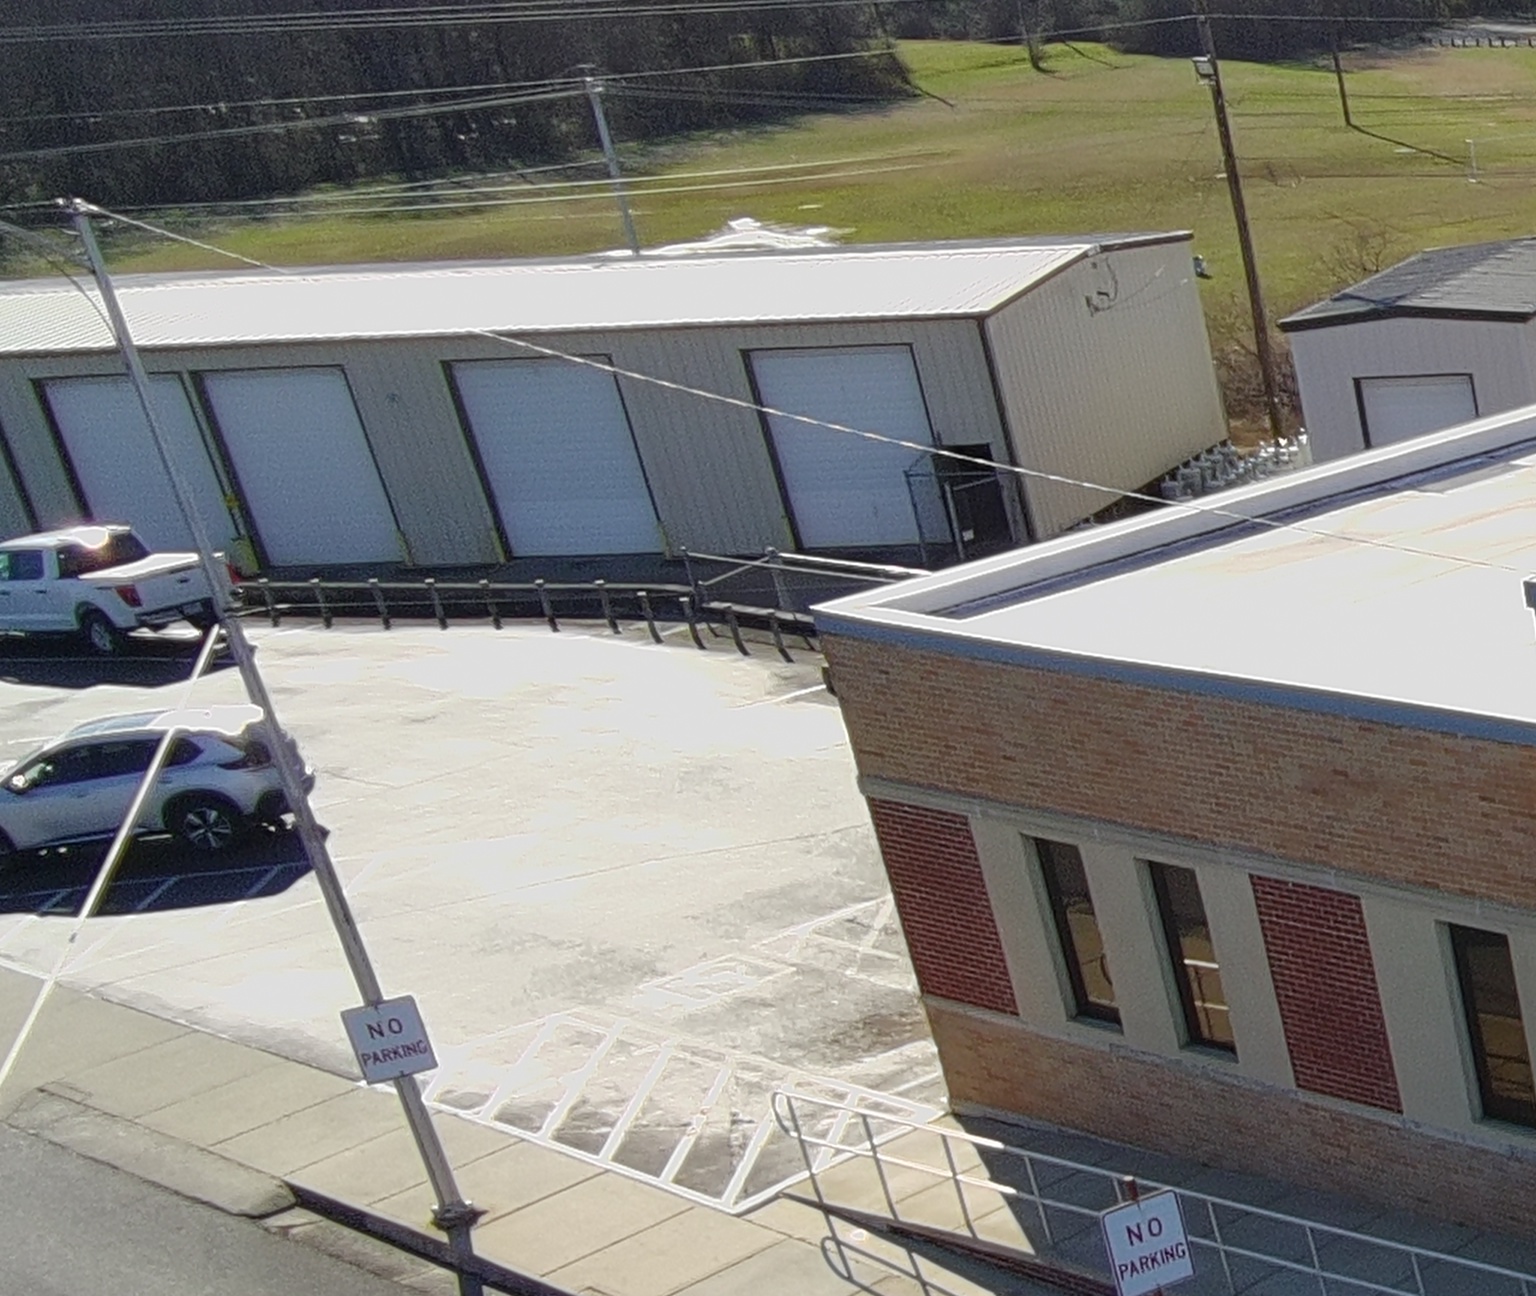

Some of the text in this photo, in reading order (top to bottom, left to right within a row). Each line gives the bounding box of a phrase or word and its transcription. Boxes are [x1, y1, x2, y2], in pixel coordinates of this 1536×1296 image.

[365, 1017, 403, 1040] NO
[361, 1039, 428, 1067] PARKING
[1126, 1217, 1163, 1247] NO
[1118, 1242, 1186, 1281] PARKING
